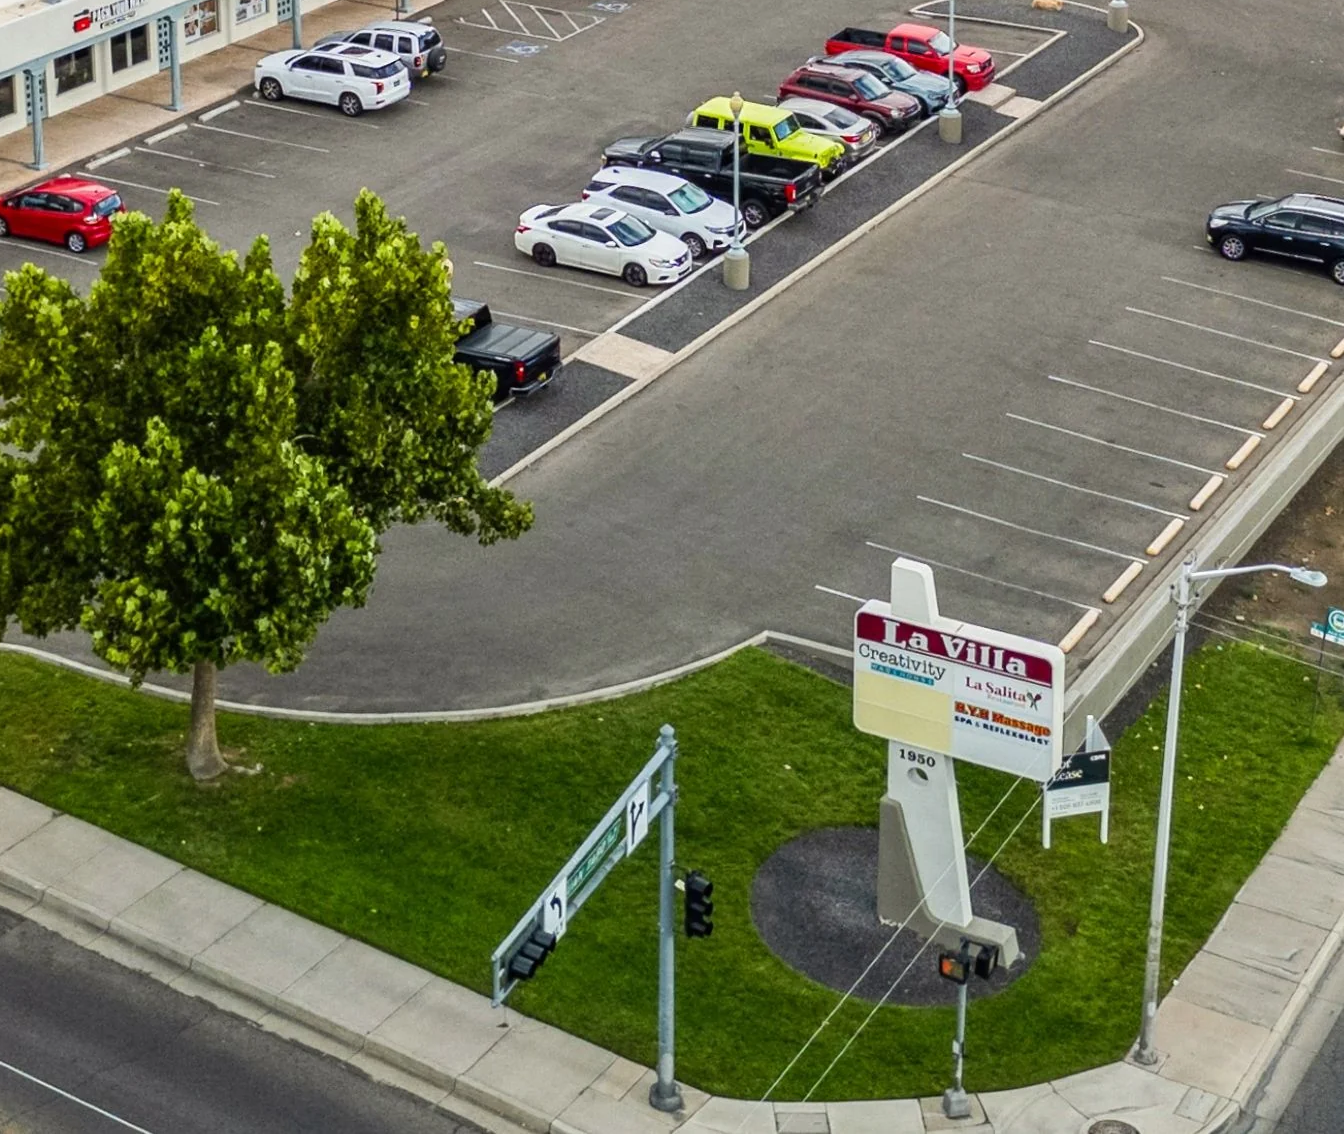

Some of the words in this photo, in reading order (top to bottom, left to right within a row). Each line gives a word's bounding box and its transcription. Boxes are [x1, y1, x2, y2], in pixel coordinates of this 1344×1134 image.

[859, 643, 946, 681] Creativity
[882, 619, 930, 652] La
[940, 634, 1028, 677] Villa
[965, 676, 983, 691] La
[985, 681, 1027, 703] Salita
[954, 715, 973, 726] SPA
[983, 723, 1050, 746] REFLEXOLOGY
[992, 710, 1052, 737] Massage
[899, 748, 936, 768] 1950
